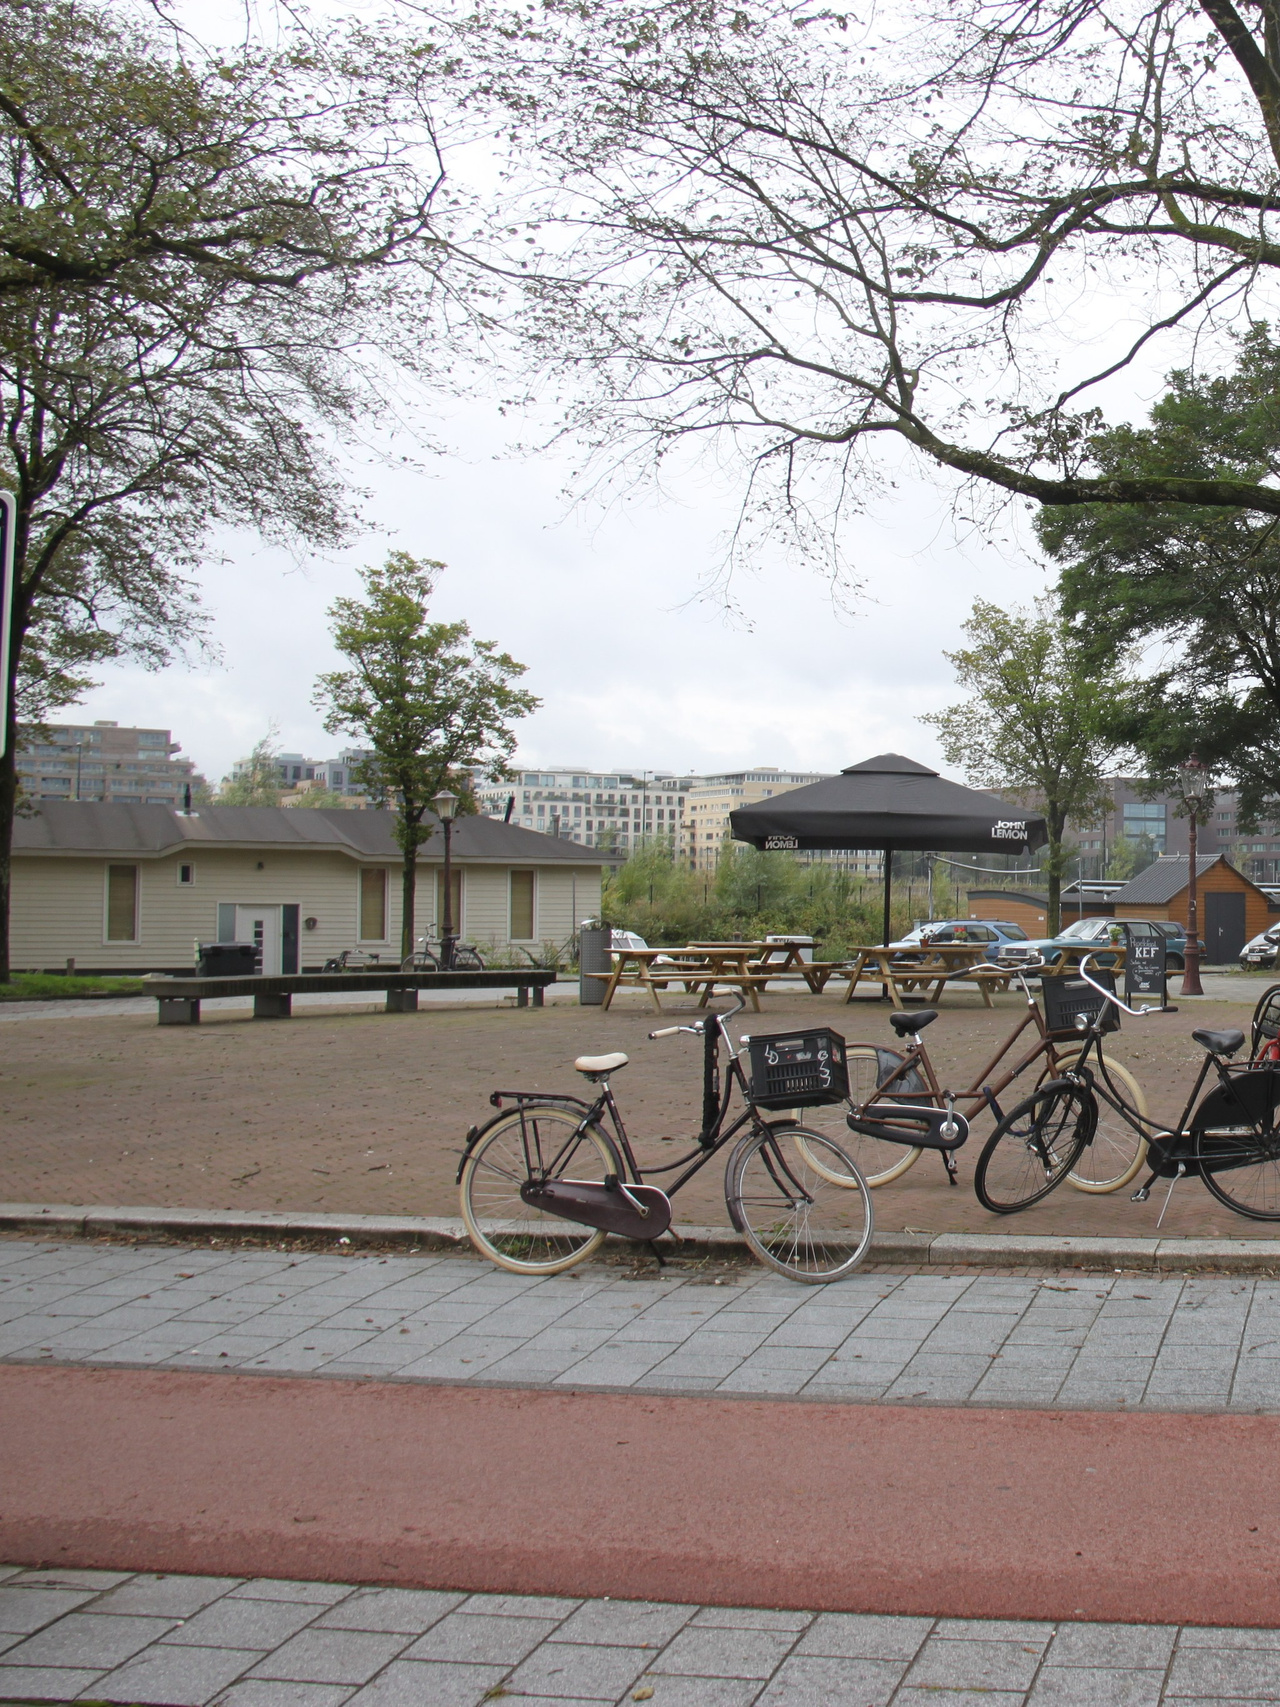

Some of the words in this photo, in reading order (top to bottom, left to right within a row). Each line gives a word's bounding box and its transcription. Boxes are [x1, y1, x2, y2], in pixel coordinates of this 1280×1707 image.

[994, 820, 1026, 830] JOHN
[991, 827, 1028, 840] LEMON
[1135, 947, 1159, 958] KEF
